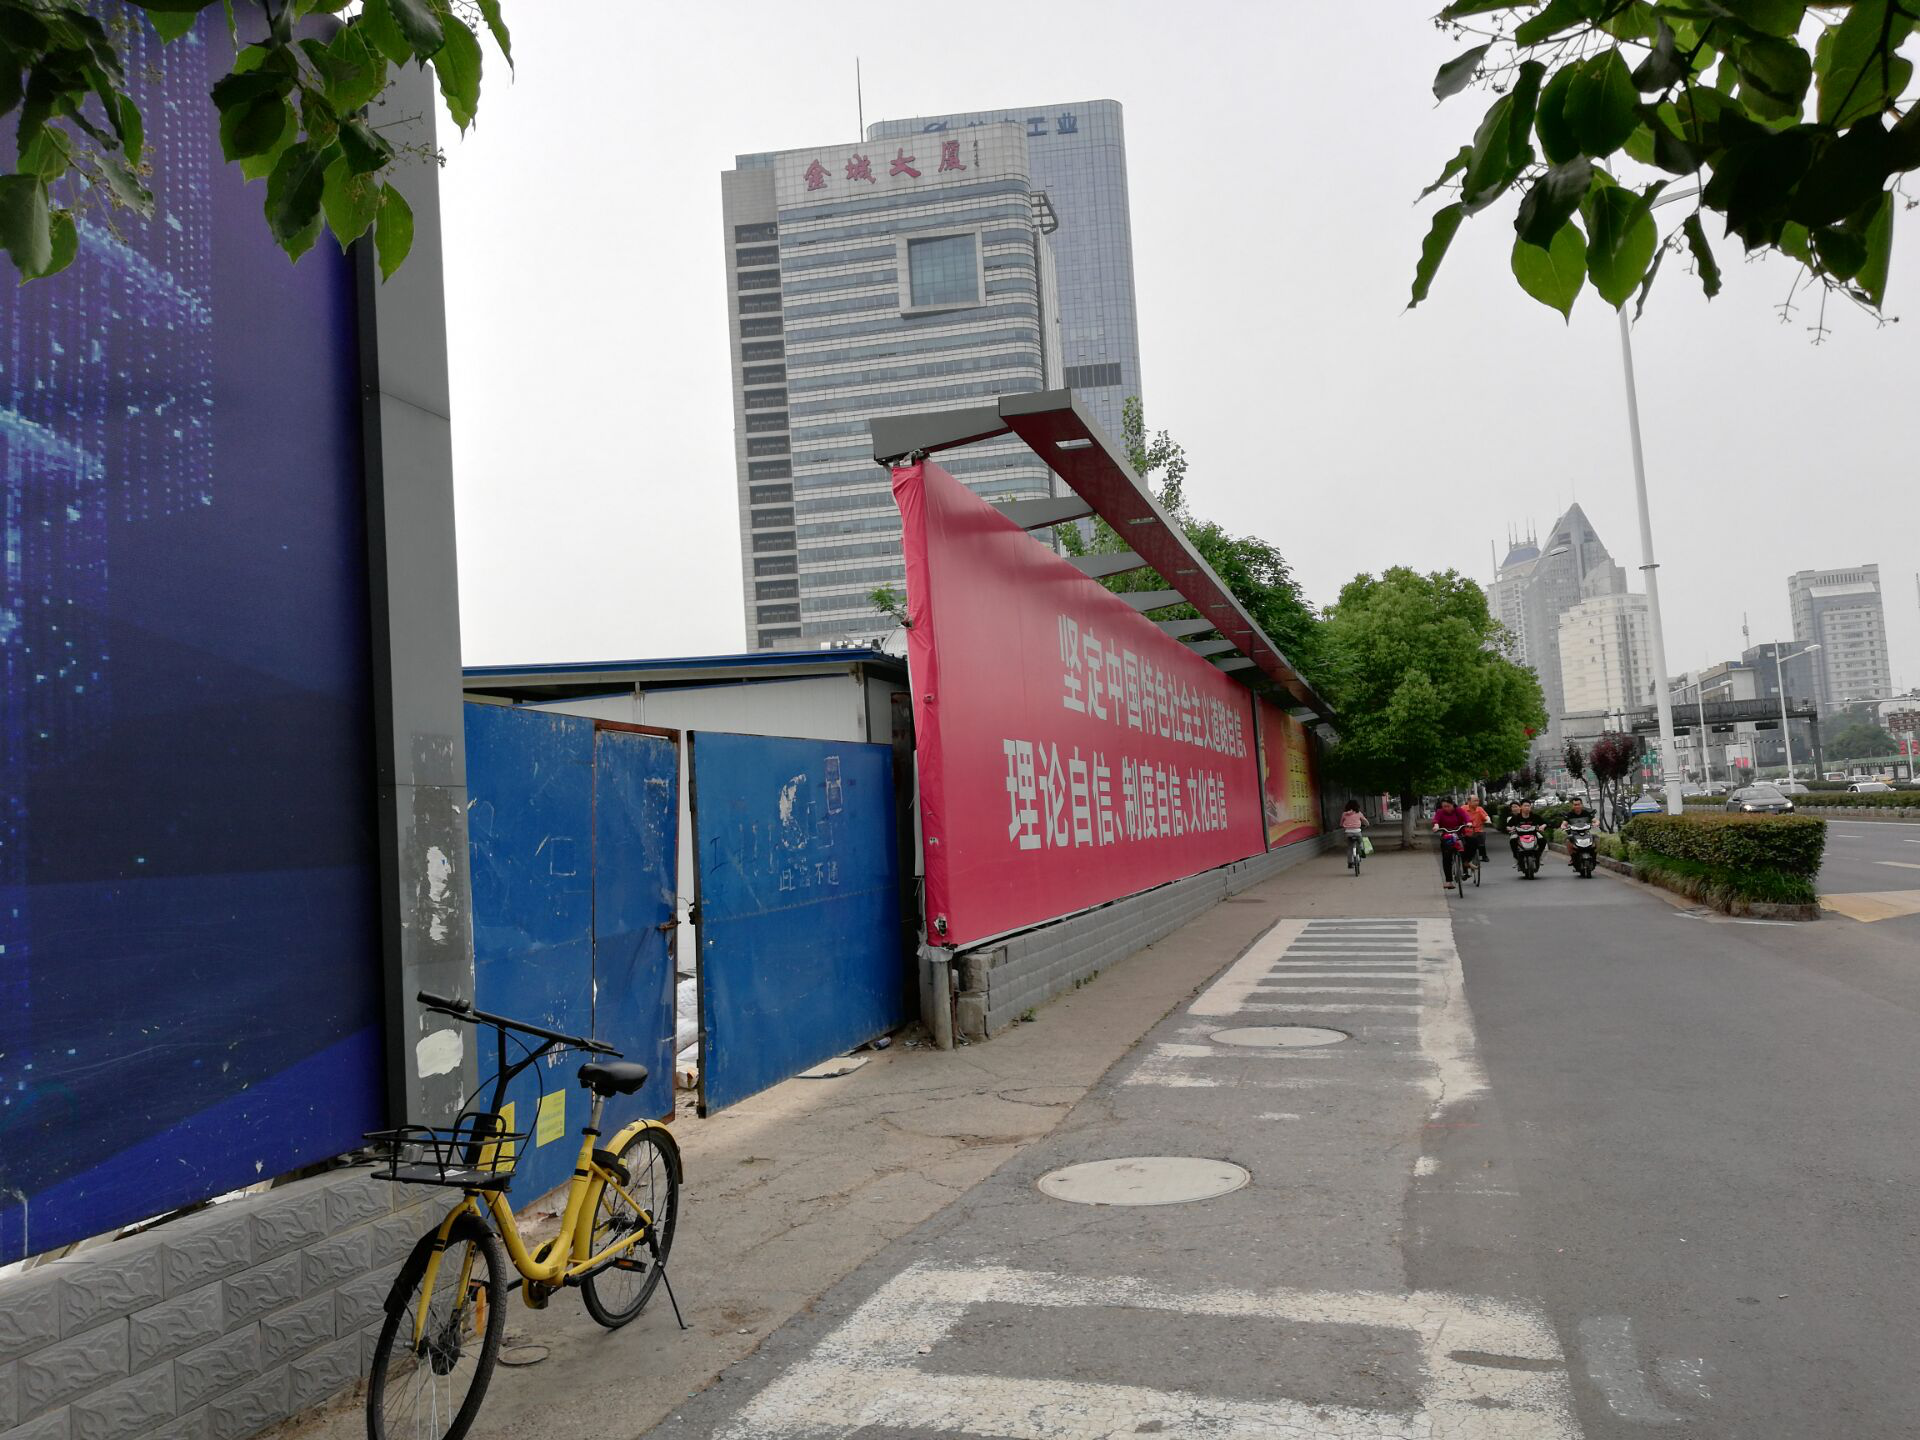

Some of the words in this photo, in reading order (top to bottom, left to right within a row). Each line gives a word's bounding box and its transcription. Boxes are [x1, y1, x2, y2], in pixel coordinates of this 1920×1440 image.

[804, 140, 967, 191] 金城大厦
[1003, 738, 1228, 850] 理论自信、制度自信、文化自信
